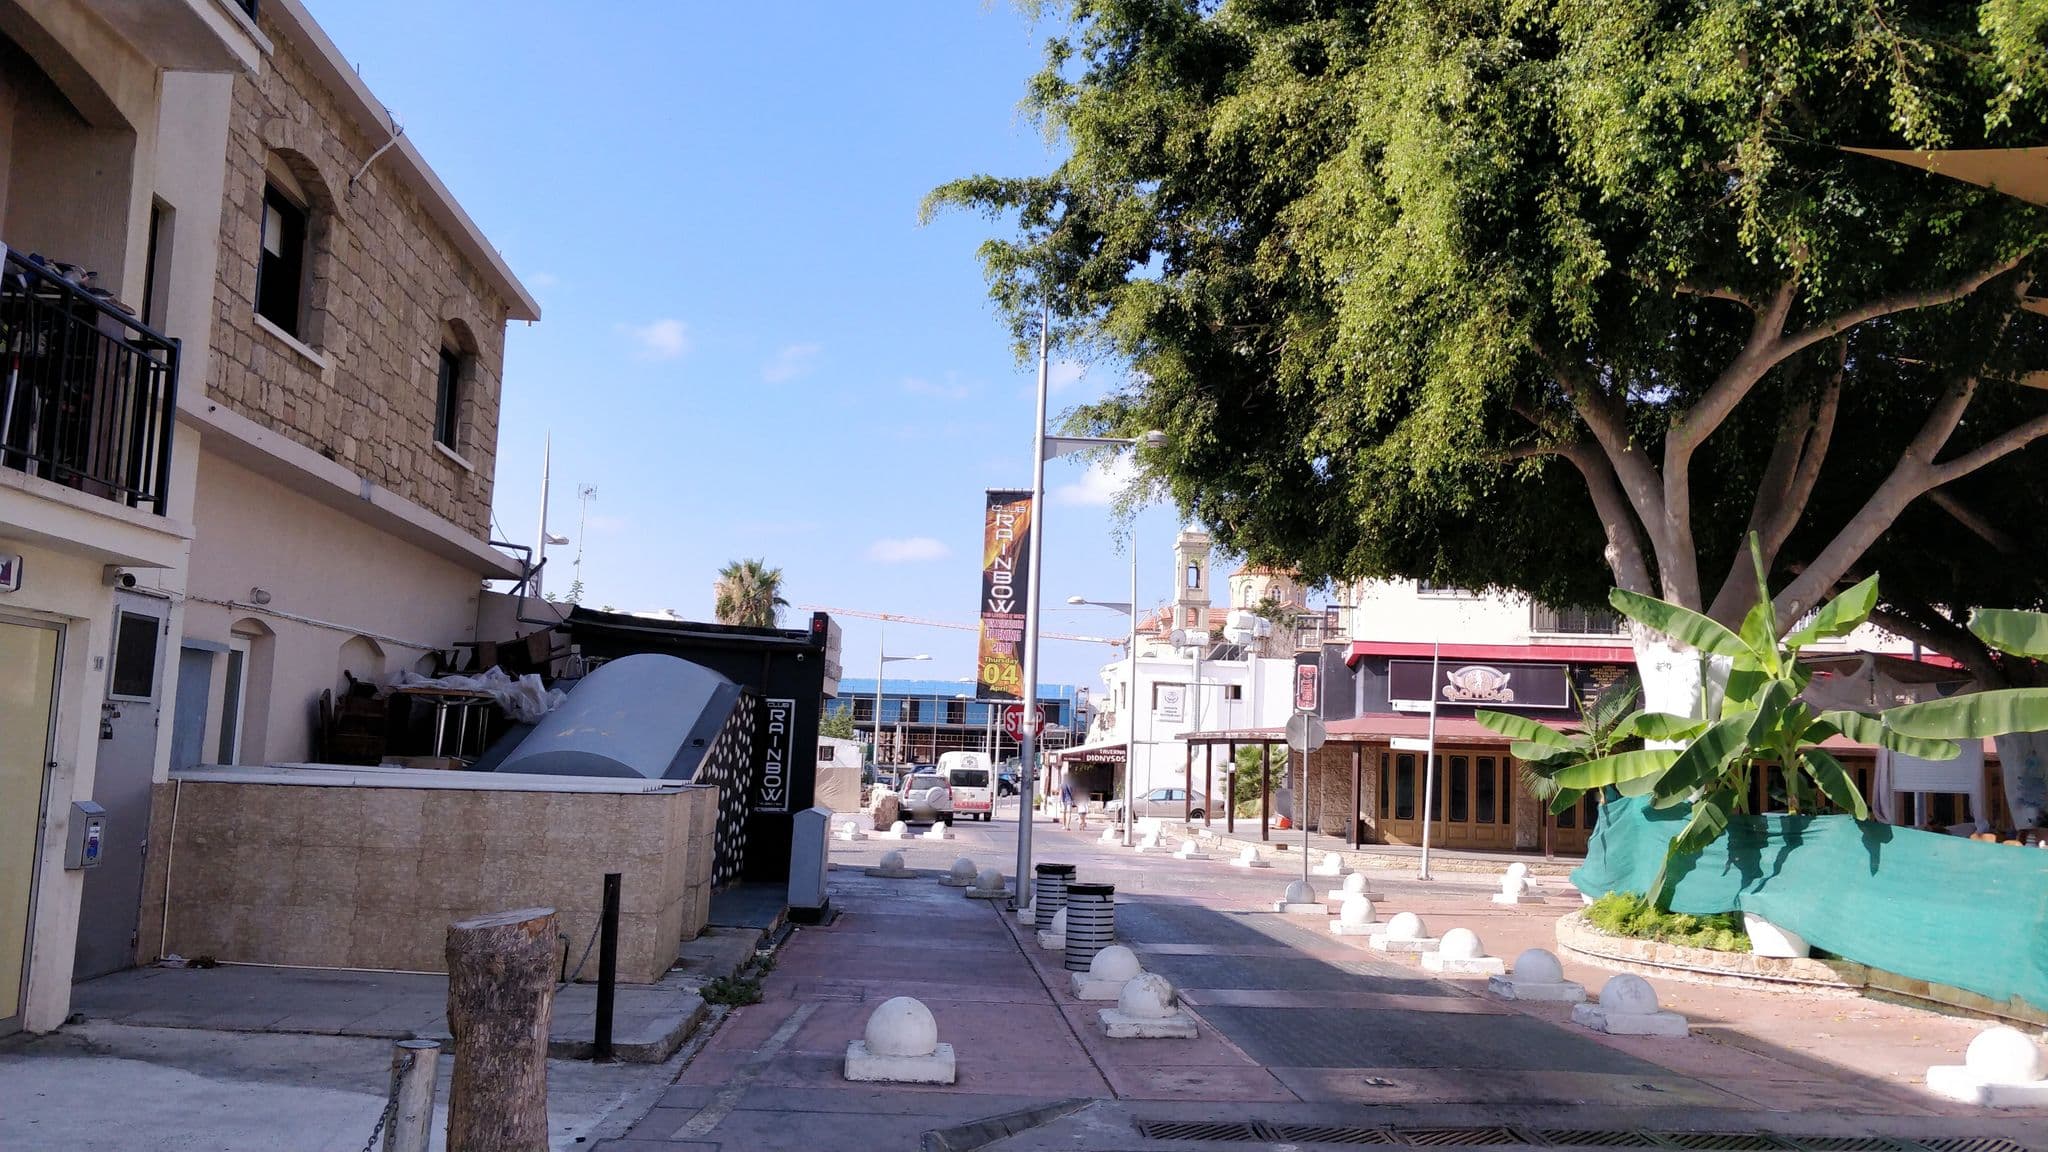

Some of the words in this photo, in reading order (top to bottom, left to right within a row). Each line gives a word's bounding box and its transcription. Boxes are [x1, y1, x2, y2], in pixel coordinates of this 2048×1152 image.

[991, 504, 1027, 513] CLUB
[988, 512, 1016, 613] RAINBOW
[984, 655, 1019, 665] Thursday
[983, 663, 1019, 685] 04
[1007, 711, 1043, 733] STP
[760, 709, 785, 801] RAINBOW
[1086, 754, 1126, 763] DIONYSOS
